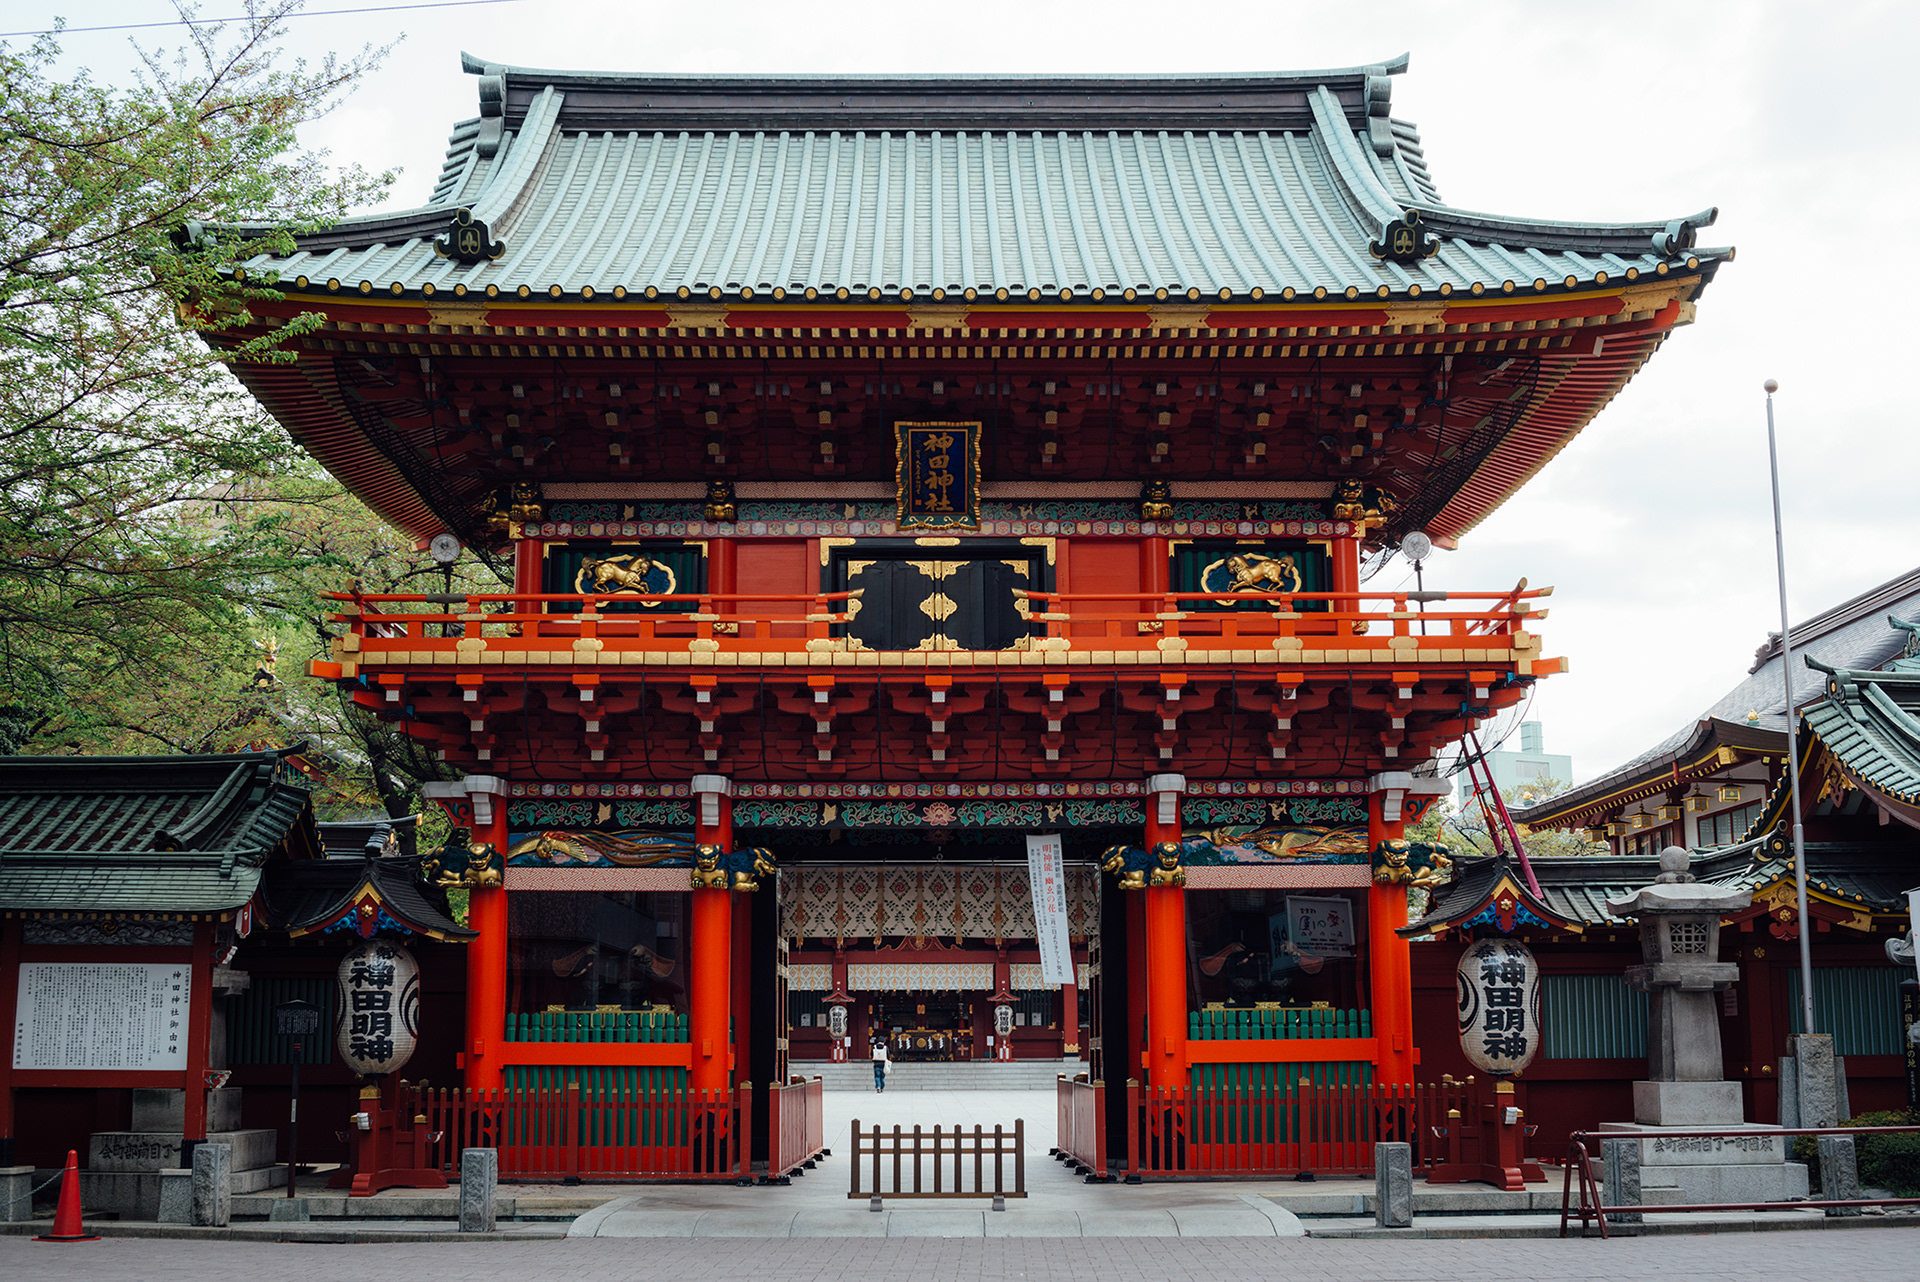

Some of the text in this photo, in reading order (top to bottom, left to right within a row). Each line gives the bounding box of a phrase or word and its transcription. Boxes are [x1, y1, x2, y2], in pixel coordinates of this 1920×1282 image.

[923, 431, 954, 512] 神田神社
[168, 970, 182, 1054] 神田神社御由緒
[348, 961, 396, 1064] 神田明神
[1480, 958, 1527, 1060] 神田明神
